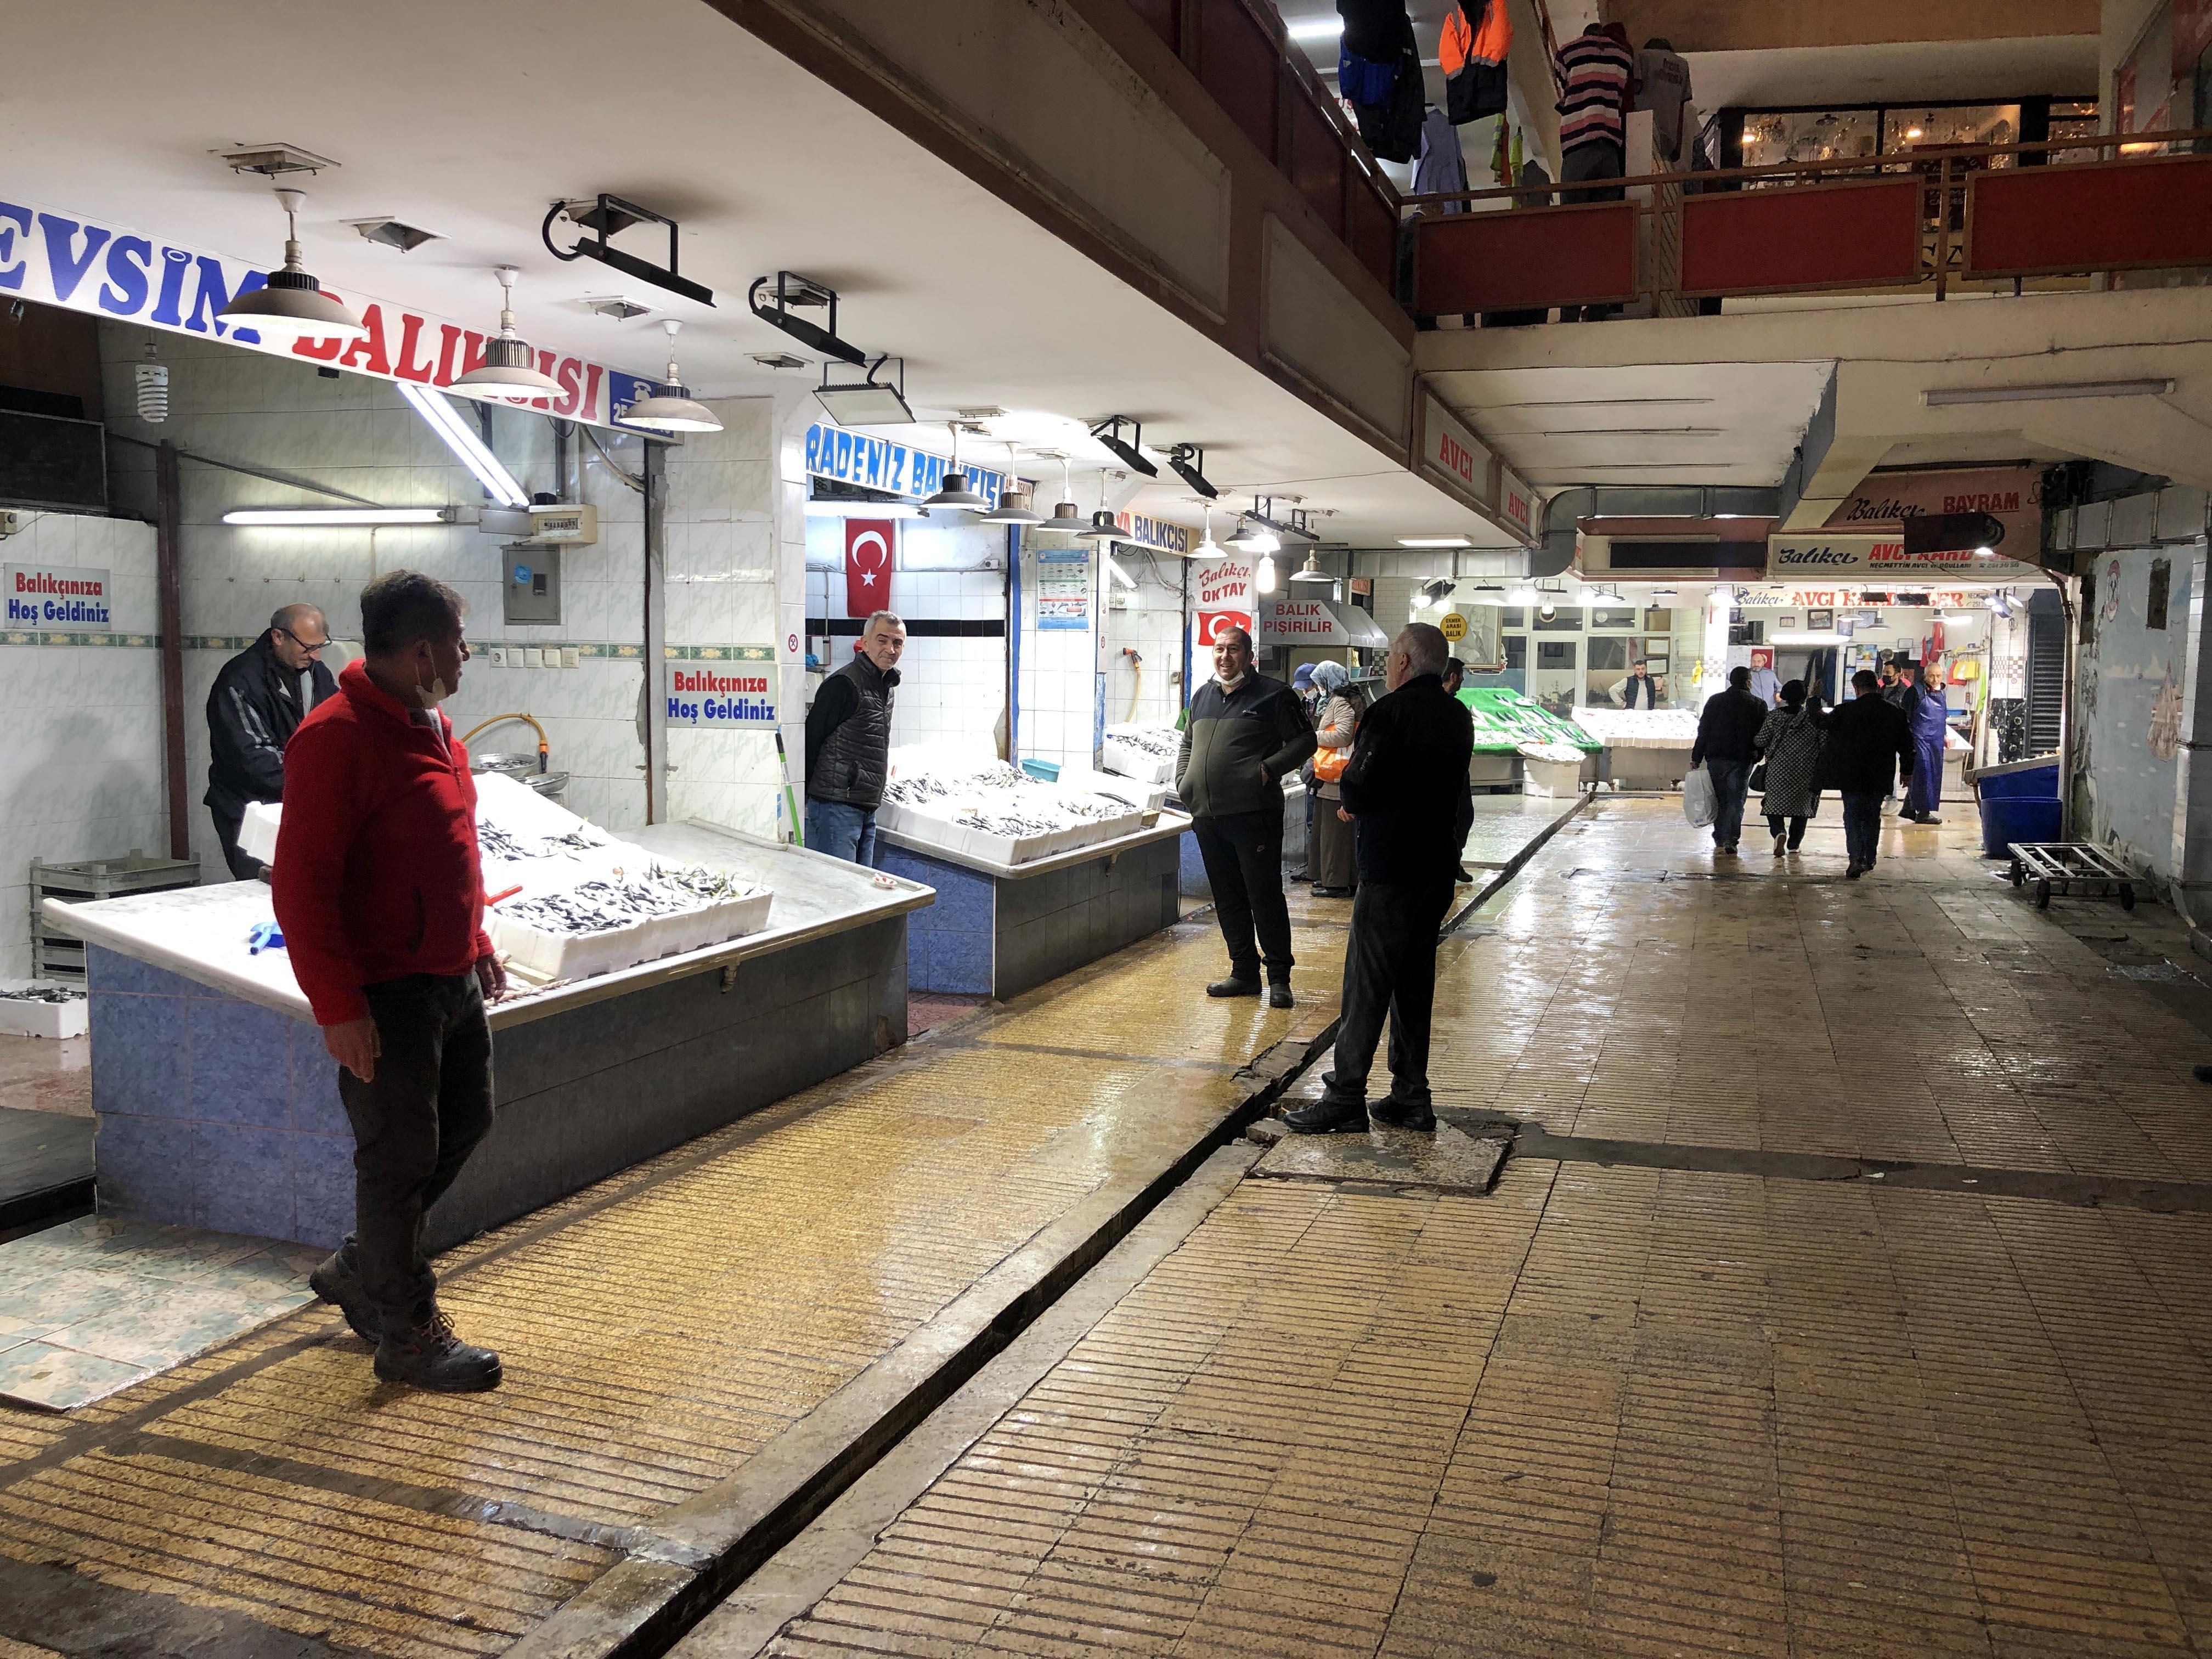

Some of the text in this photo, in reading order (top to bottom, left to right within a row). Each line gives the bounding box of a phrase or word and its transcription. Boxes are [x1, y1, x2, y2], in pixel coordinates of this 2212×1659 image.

[292, 290, 603, 420] ALIKISI
[1440, 432, 1473, 483] AVCI
[1508, 492, 1528, 526] AVCI
[1944, 492, 2019, 514] BAYRAM
[1135, 515, 1188, 553] BALIKÇISI
[1779, 547, 1859, 566] Balıkçı
[16, 572, 103, 600] Balıkçınıza
[1202, 583, 1246, 602] OKTAY
[1791, 591, 1835, 606] AVCI
[9, 599, 109, 625] Hoş Geldiniz
[1276, 604, 1321, 616] BALIK
[1263, 618, 1333, 636] PİŞİRİLİR
[674, 670, 768, 698] Balıkçınıza
[668, 698, 775, 724] Hoş Geldiniz
